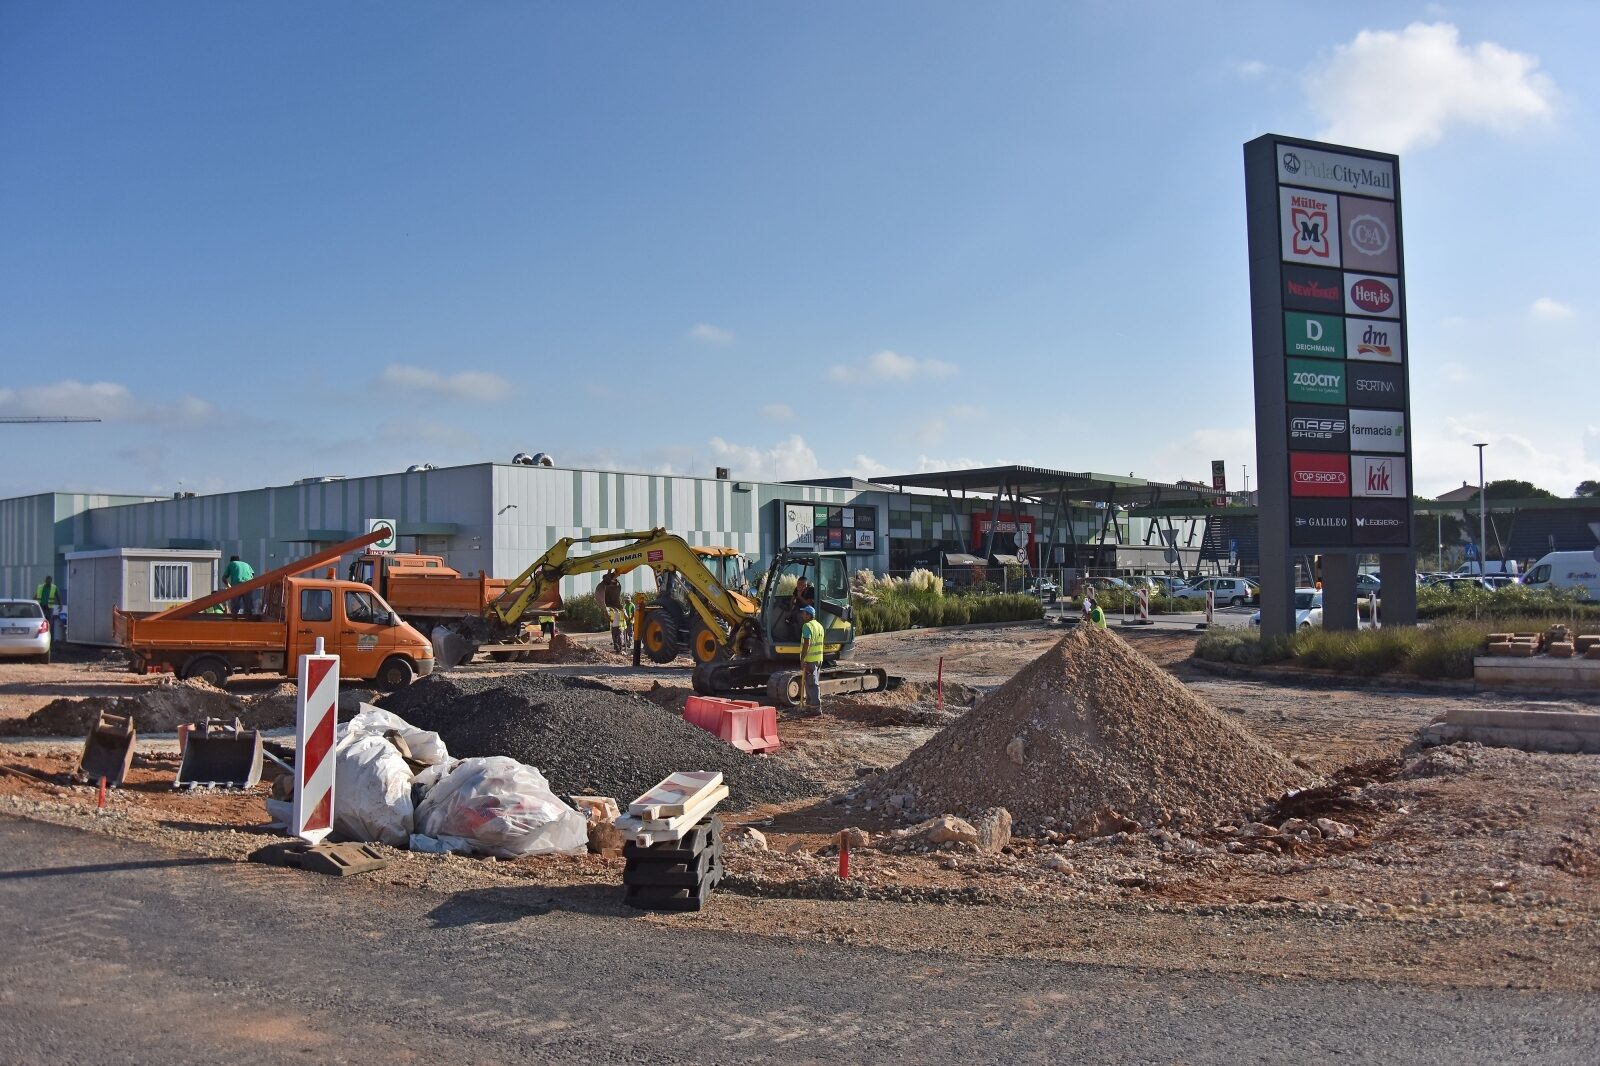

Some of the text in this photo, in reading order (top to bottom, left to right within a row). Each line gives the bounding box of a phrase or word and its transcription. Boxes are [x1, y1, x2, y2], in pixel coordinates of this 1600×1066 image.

[1291, 195, 1328, 211] Müller
[1301, 221, 1320, 243] M
[1356, 225, 1382, 246] C&A
[1355, 285, 1391, 306] Hervis
[1306, 319, 1323, 341] D
[1362, 324, 1388, 346] dm
[1295, 343, 1335, 353] DEICHMANN
[1356, 379, 1395, 393] SPORTINA
[1292, 419, 1346, 432] MASS
[1351, 424, 1392, 437] farmacia
[1291, 431, 1333, 439] SHOES
[1298, 472, 1337, 482] TOP SHOP
[1367, 464, 1389, 491] kik
[1308, 517, 1347, 527] GALILEO
[1364, 518, 1399, 527] LEGGIERO
[609, 552, 643, 564] YANMAR
